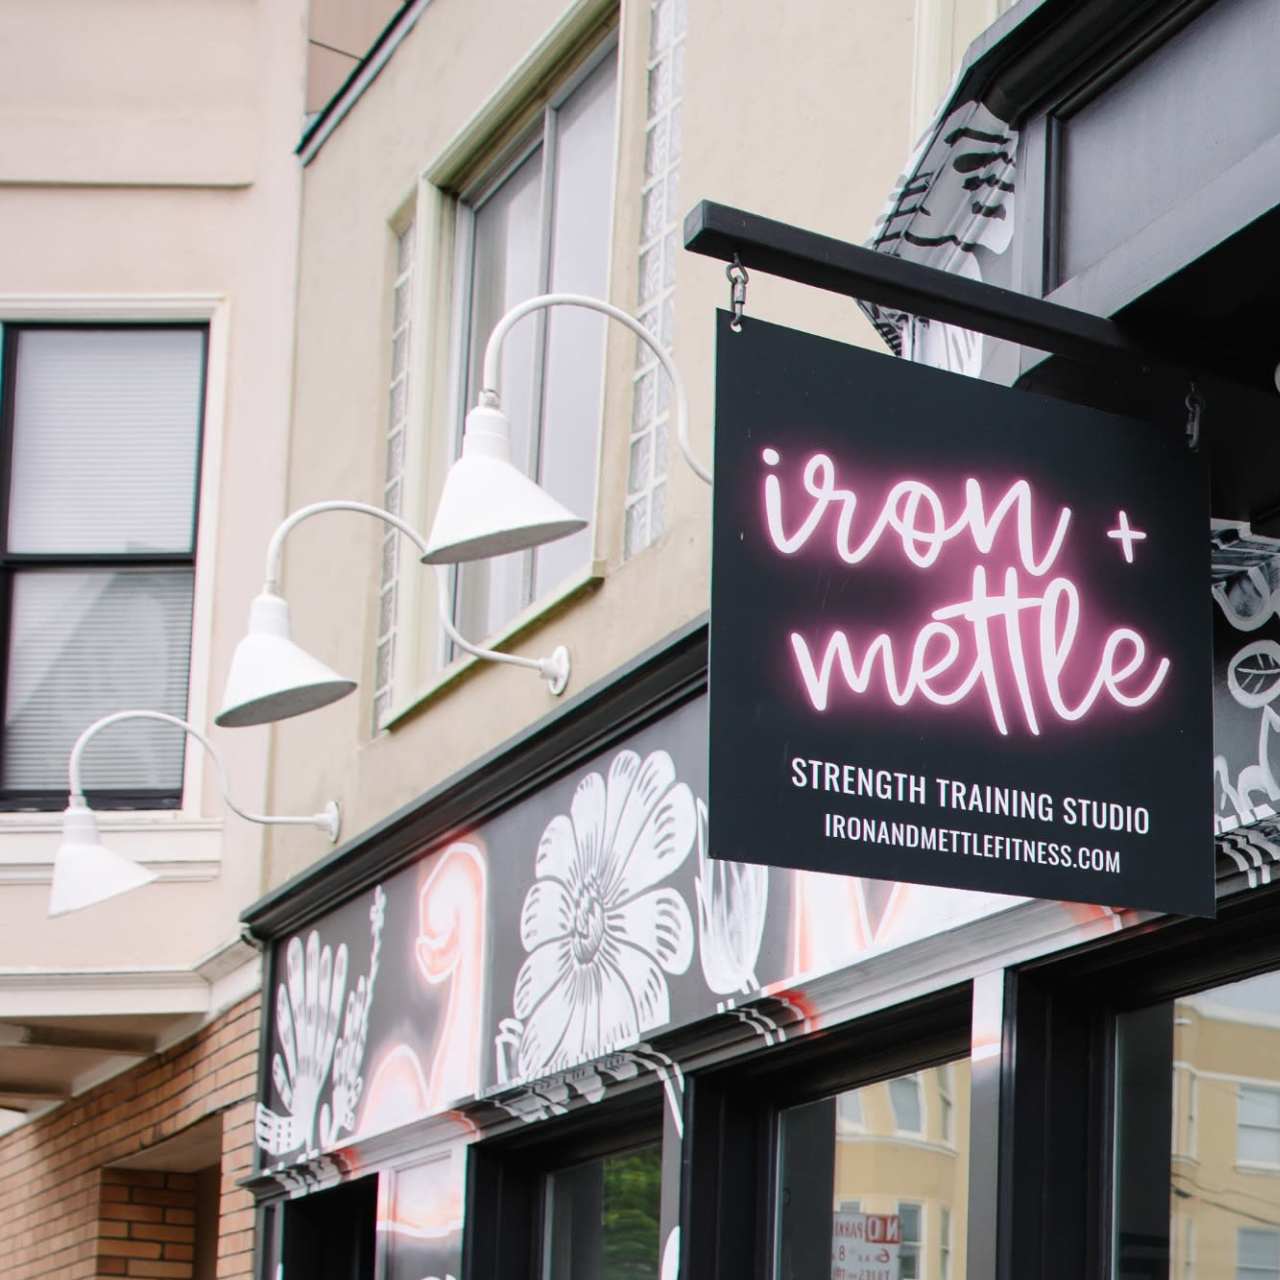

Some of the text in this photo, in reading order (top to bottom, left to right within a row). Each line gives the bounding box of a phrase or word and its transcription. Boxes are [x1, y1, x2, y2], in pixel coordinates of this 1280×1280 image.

[762, 448, 1071, 576] iron
[790, 565, 1170, 735] mettle
[791, 757, 1150, 834] STRENGTH TRAINING STUDIO
[824, 813, 1121, 874] IRONANDMETTLEFITNESS.COM
